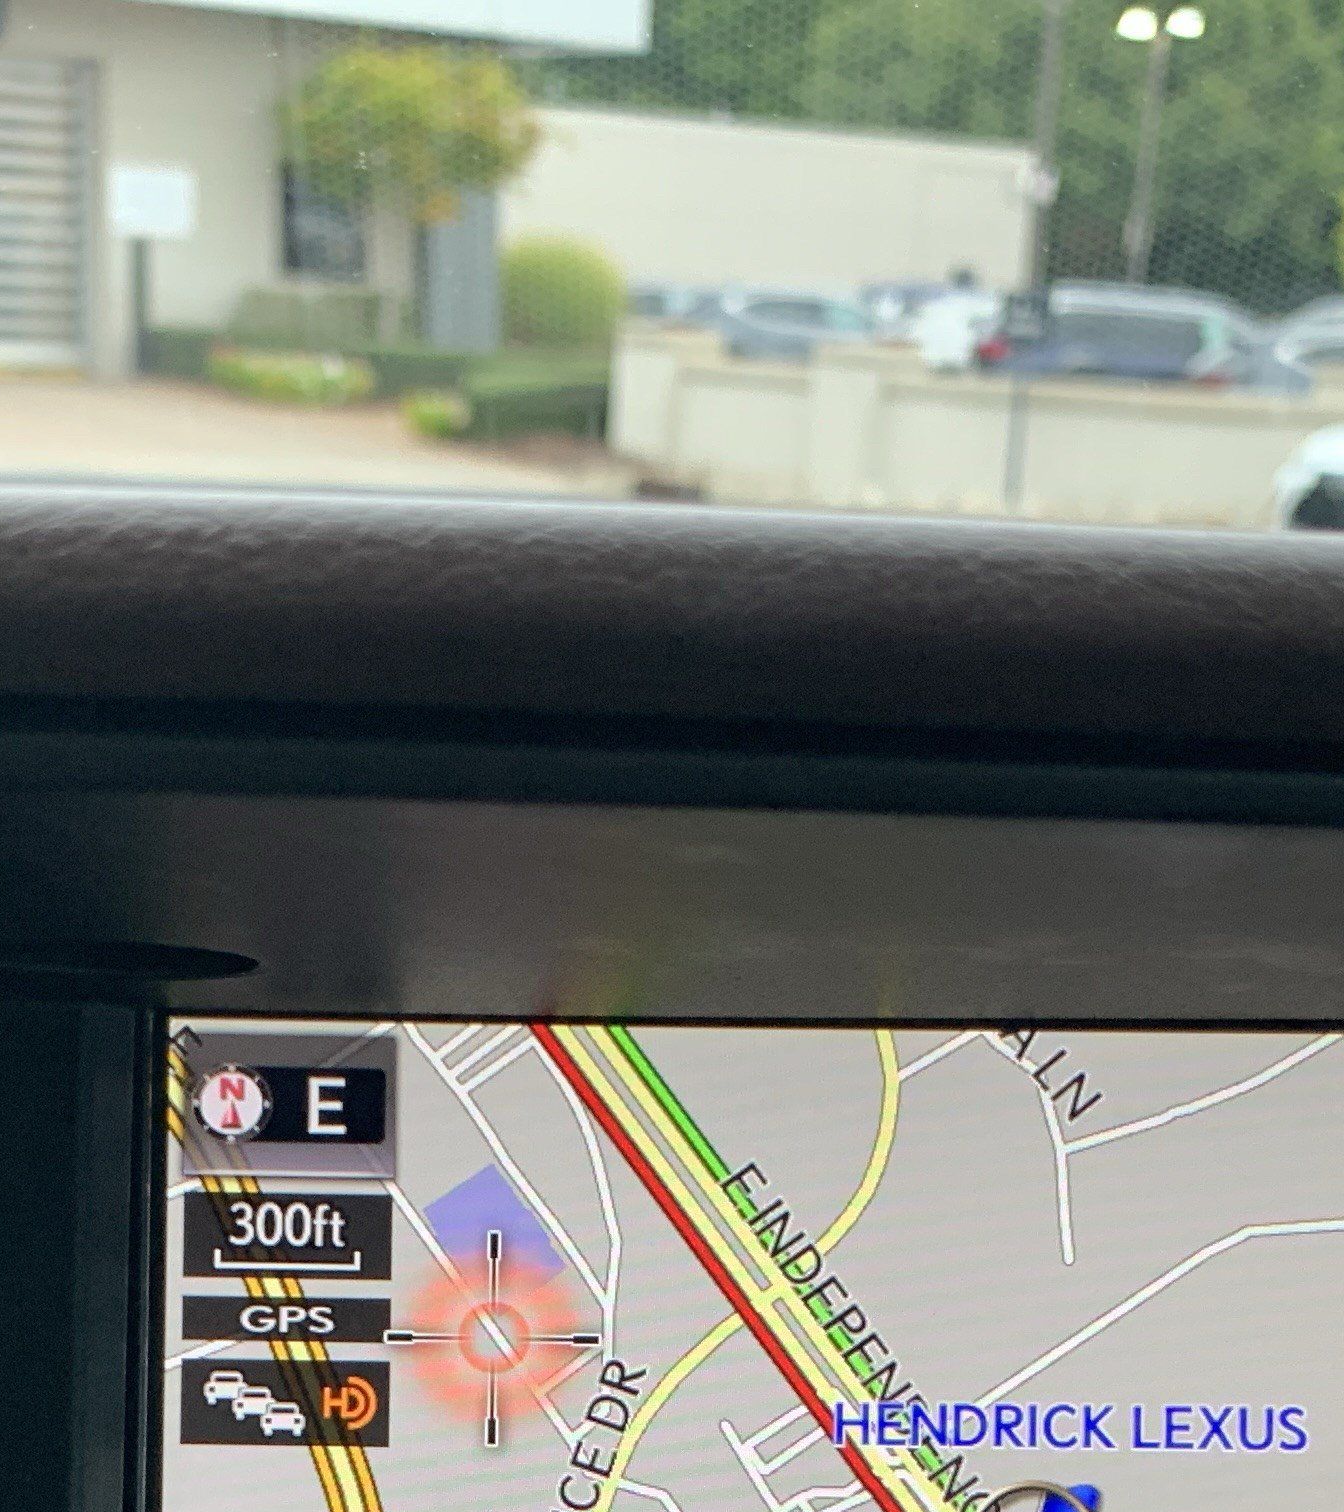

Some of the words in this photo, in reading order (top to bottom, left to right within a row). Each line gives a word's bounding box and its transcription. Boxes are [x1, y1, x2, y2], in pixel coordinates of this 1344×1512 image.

[219, 1077, 246, 1100] N
[308, 1077, 347, 1134] E
[1032, 1049, 1103, 1121] LN
[721, 1162, 768, 1208] E
[228, 1202, 345, 1249] 300ft
[240, 1306, 335, 1334] GPS
[587, 1359, 647, 1433] DR
[834, 1402, 1117, 1450] HENDRICK
[1133, 1406, 1308, 1450] LEXUS
